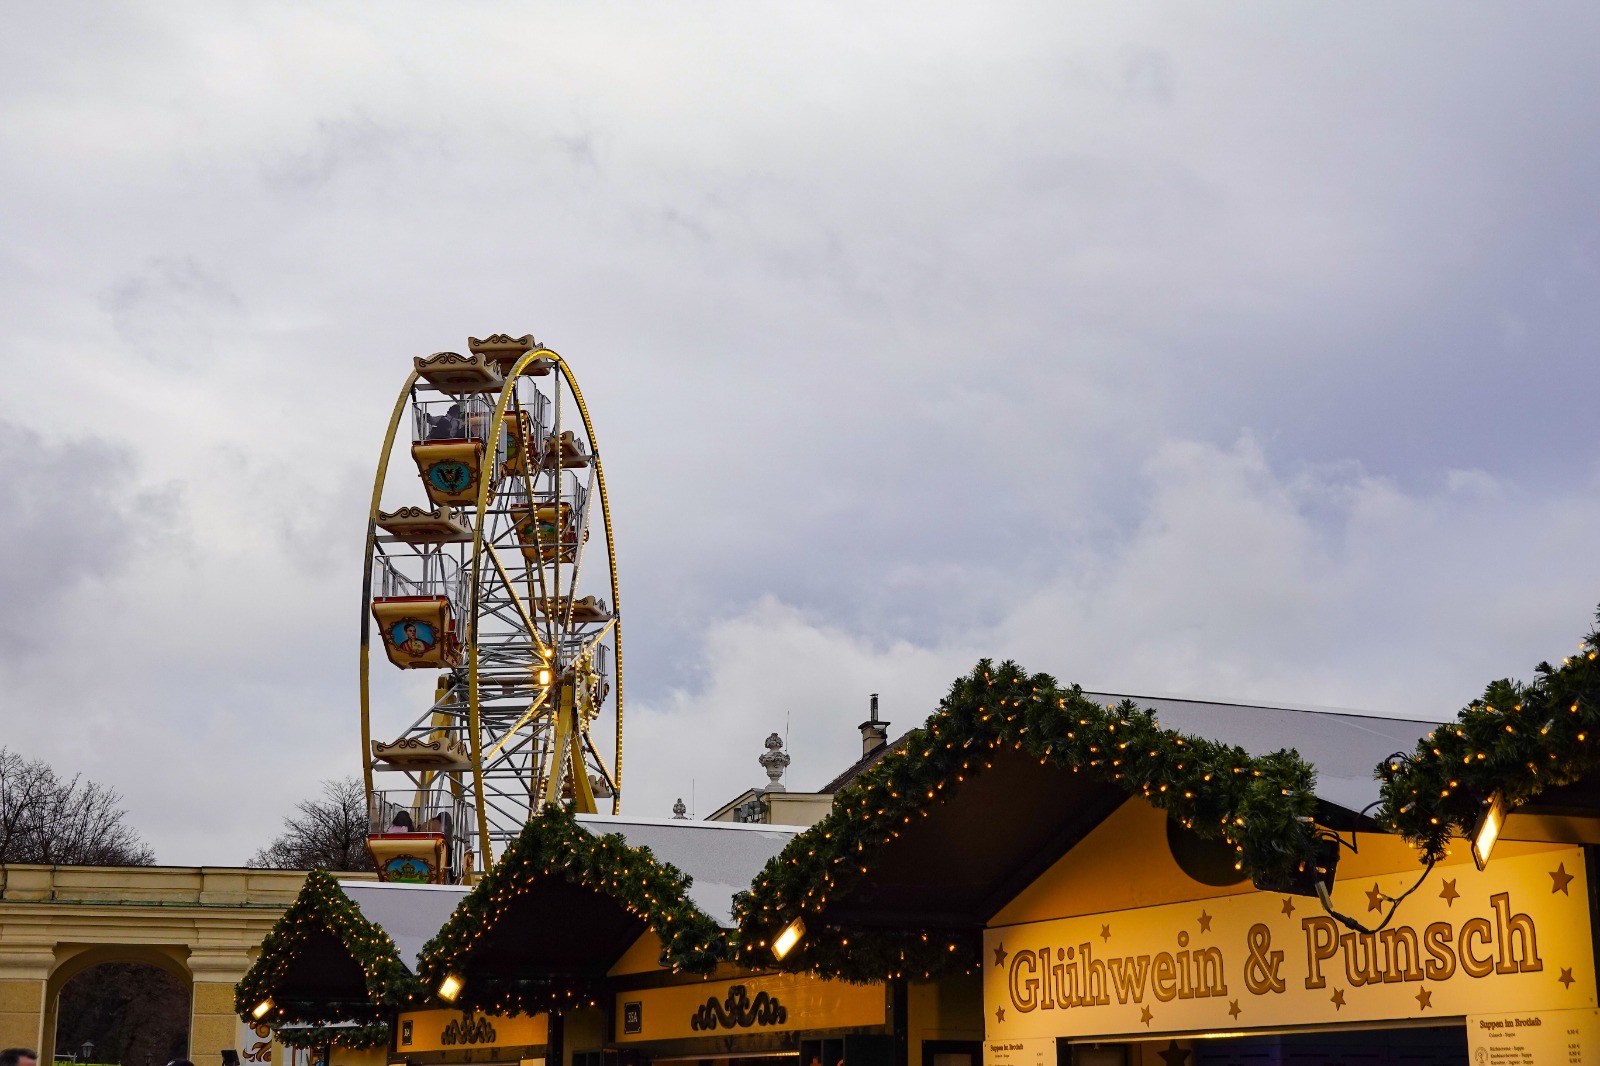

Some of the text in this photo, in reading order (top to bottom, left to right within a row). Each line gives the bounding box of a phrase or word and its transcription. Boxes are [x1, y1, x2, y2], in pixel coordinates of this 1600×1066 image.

[1009, 892, 1543, 1013] Glühwein & Punsch
[1479, 1017, 1542, 1030] Suppen im Brotlaib
